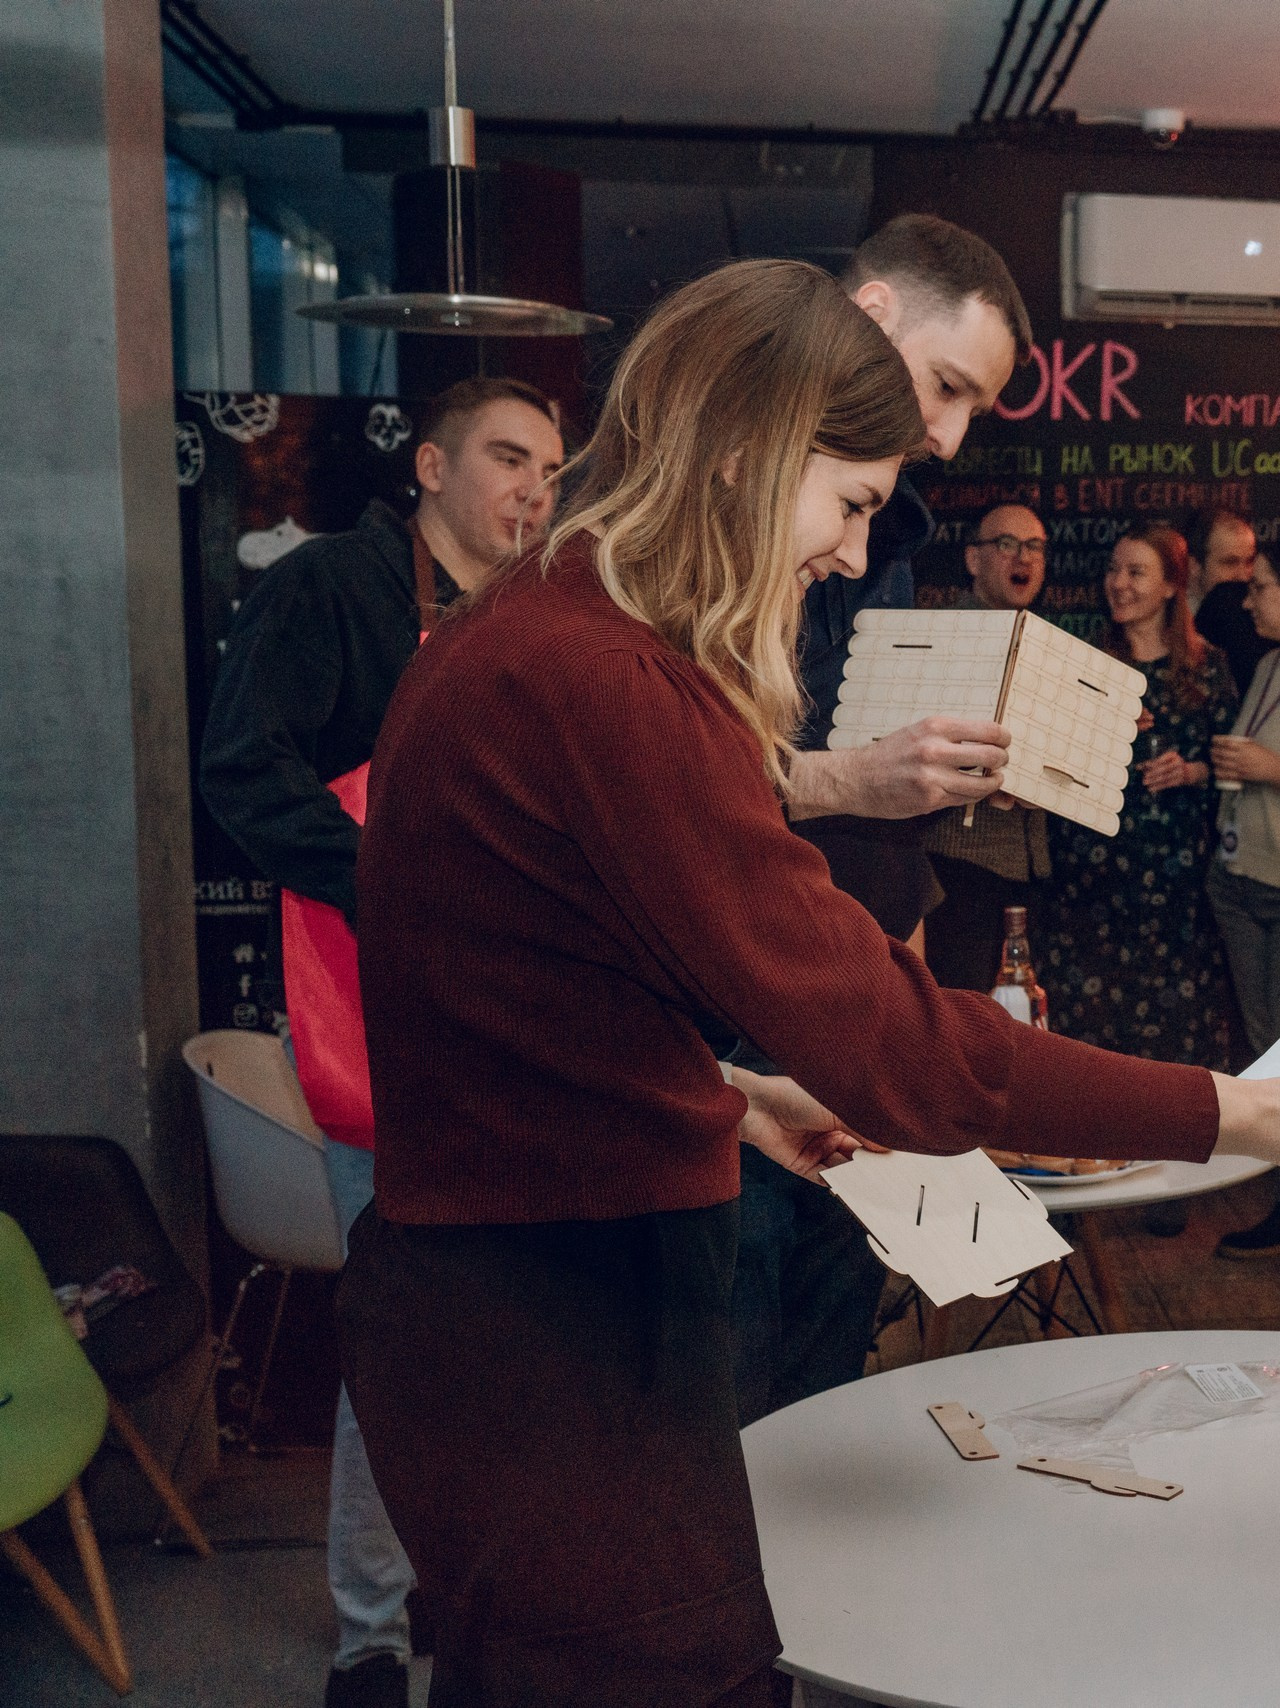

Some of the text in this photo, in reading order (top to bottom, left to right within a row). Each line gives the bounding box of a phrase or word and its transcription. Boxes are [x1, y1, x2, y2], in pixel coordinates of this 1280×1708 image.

[993, 339, 1141, 421] OKR
[1060, 444, 1096, 476] НА
[1108, 443, 1197, 475] РЫНОК
[1054, 483, 1070, 511] В
